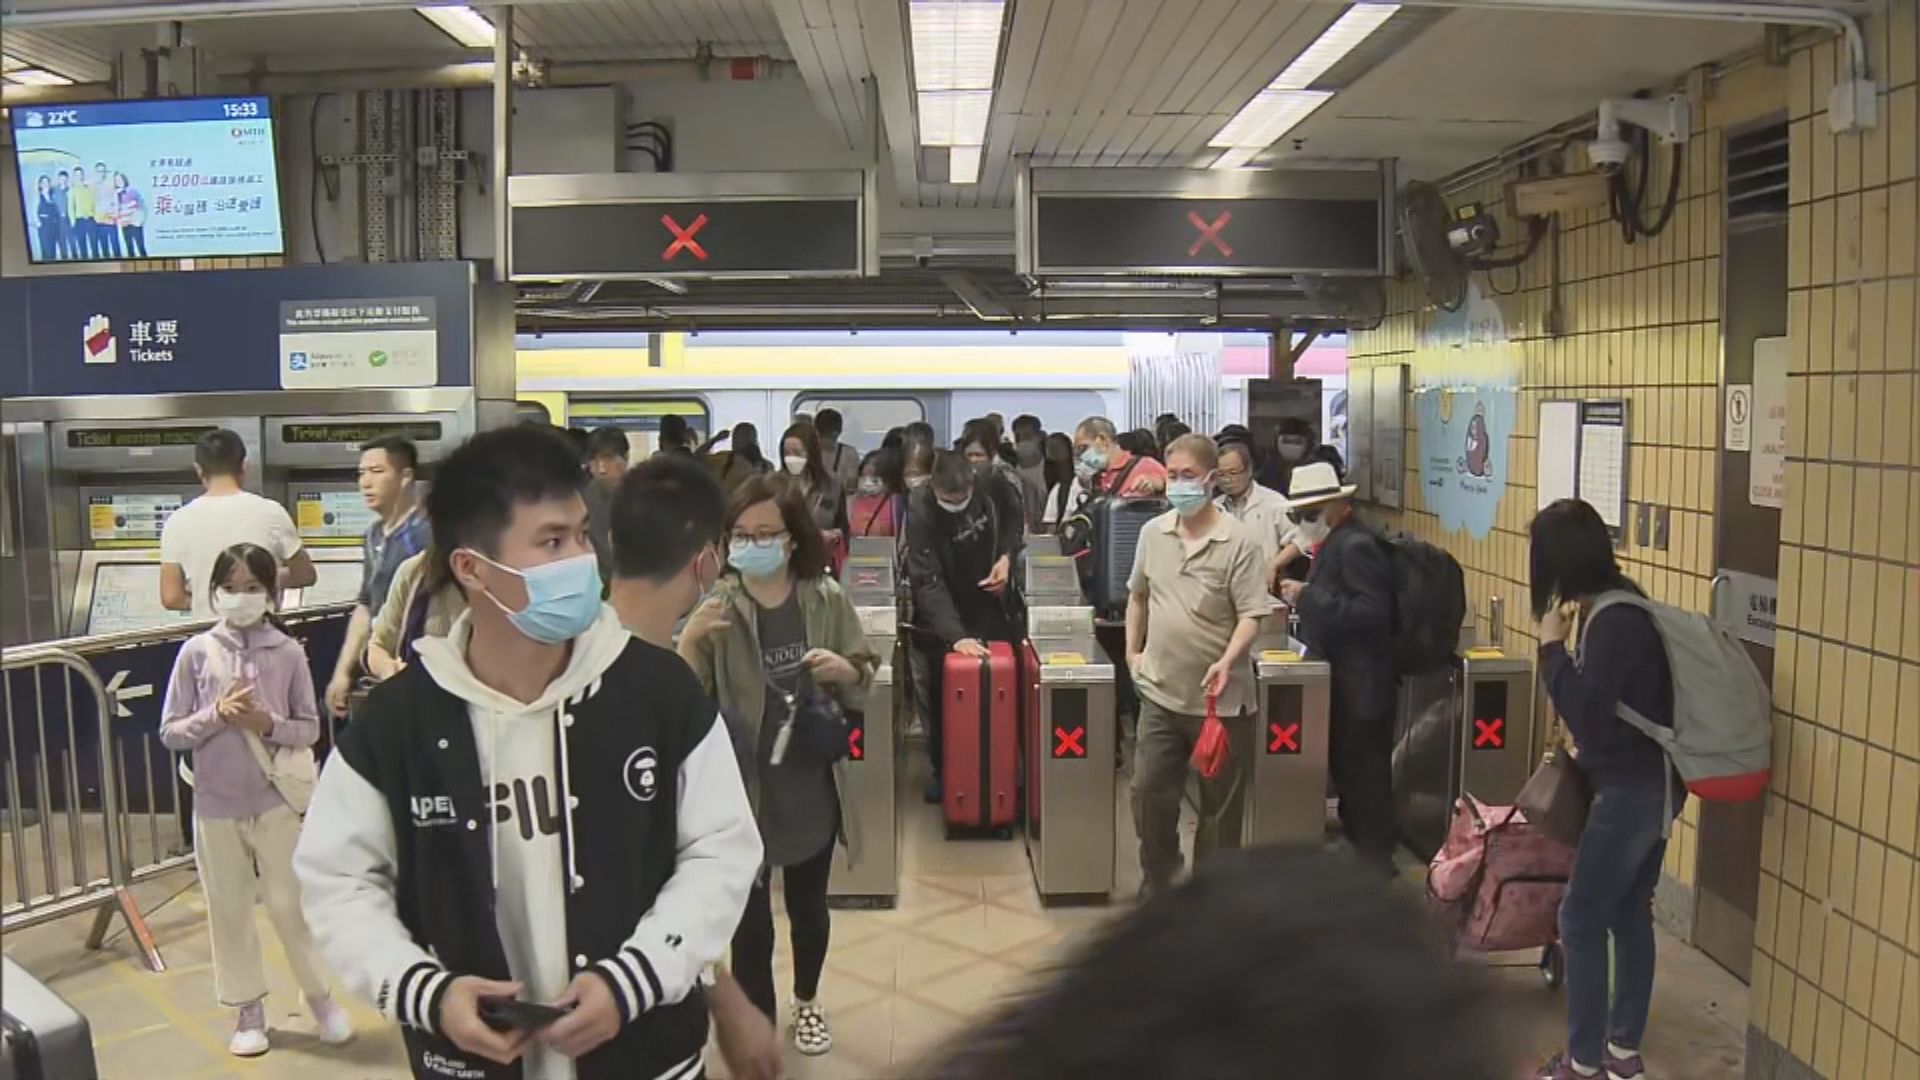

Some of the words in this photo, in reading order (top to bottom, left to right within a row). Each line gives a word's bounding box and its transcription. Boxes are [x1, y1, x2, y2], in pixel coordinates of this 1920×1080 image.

[223, 102, 258, 117] 15:33
[129, 320, 178, 346] 車票
[129, 349, 173, 362] Tickets
